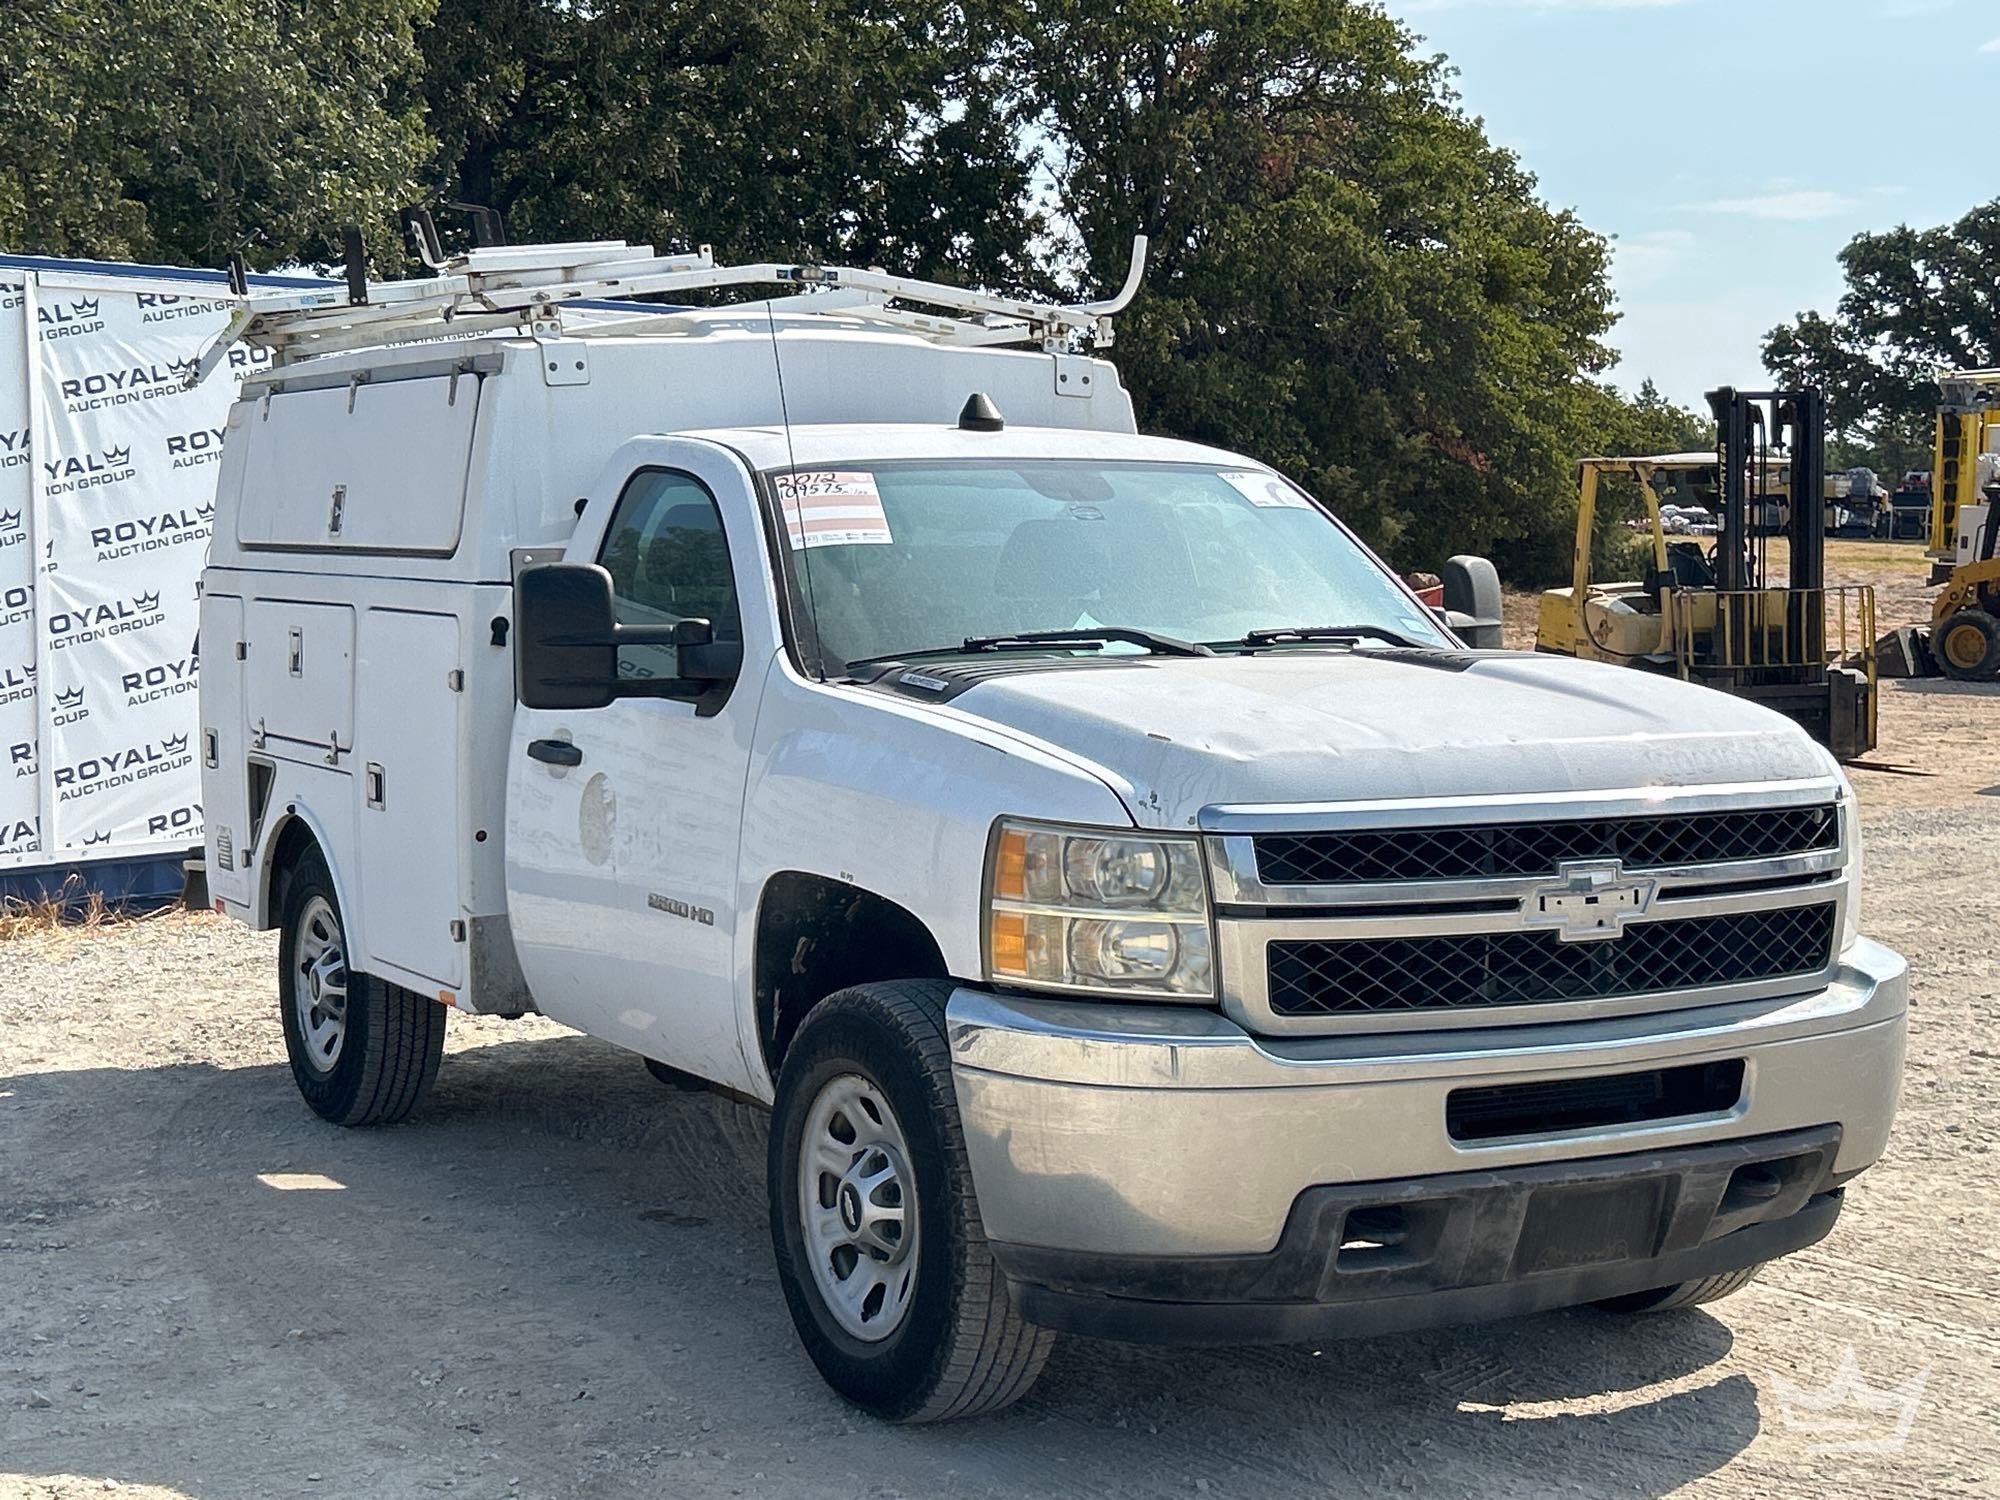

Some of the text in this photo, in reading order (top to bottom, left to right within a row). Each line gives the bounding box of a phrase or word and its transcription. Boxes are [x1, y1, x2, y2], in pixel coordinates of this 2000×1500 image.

[142, 303, 212, 323] AUCTION
[46, 321, 105, 340] GROUP
[61, 365, 168, 399] ROYAL
[68, 392, 140, 414] AUCTION
[78, 469, 136, 490] GROUP
[91, 509, 197, 548] ROYAL
[97, 537, 169, 562] AUCTION
[109, 613, 165, 636] GROUP
[127, 680, 198, 707] AUCTION
[54, 744, 163, 788] ROYAL
[59, 755, 193, 802] AUCTION GROUP
